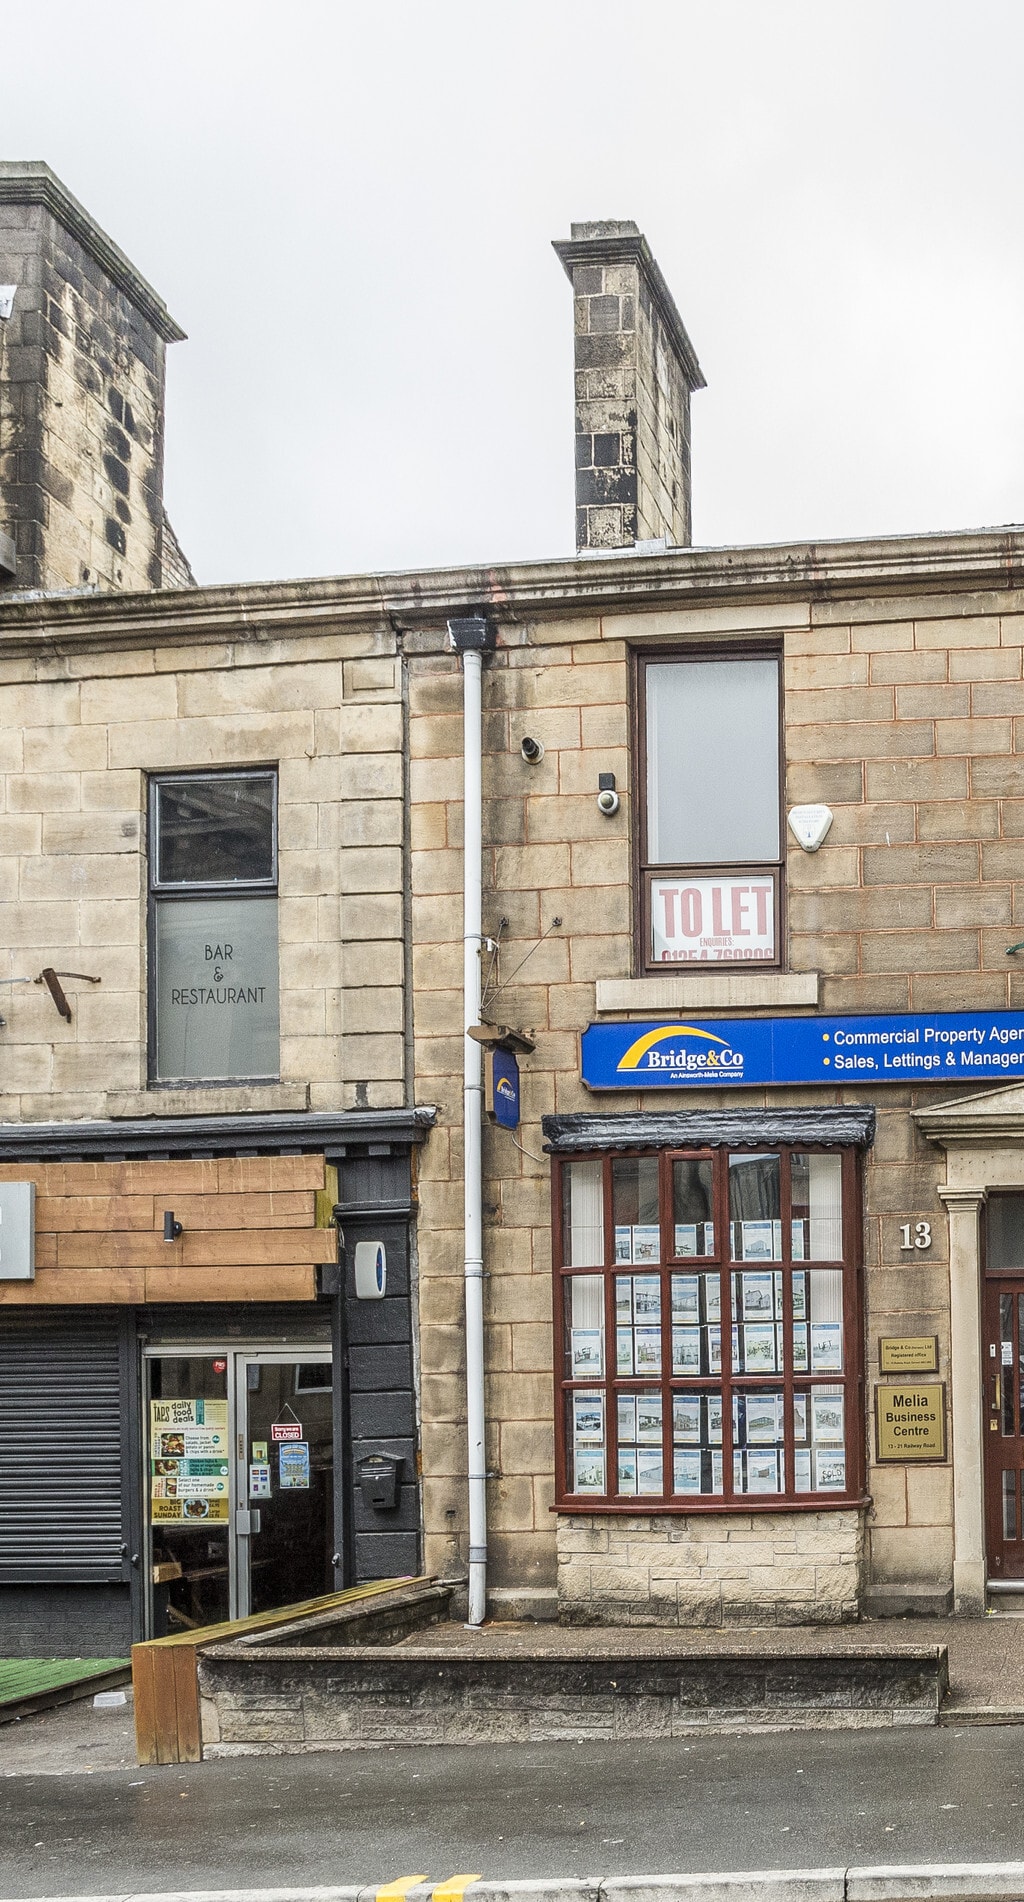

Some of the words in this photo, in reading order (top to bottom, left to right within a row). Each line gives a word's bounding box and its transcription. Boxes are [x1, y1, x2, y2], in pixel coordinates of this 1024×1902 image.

[658, 887, 703, 938] TO
[711, 886, 771, 937] LET
[699, 937, 735, 948] ENQUIRIES:
[204, 944, 234, 961] BAR
[213, 966, 224, 982] &
[171, 986, 266, 1005] RESTAURANT
[834, 1028, 919, 1045] Commercial
[924, 1027, 986, 1045] Property
[647, 1049, 744, 1070] Bridge&Co
[834, 1054, 879, 1070] Sales,
[884, 1052, 941, 1070] Lettings
[945, 1051, 956, 1066] &
[900, 1221, 932, 1249] 13
[171, 1400, 192, 1411] daily
[893, 1394, 928, 1407] Melia
[172, 1415, 195, 1424] deals
[173, 1408, 192, 1418] food
[886, 1411, 936, 1423] Business
[274, 1431, 300, 1439] CLOSED
[893, 1426, 930, 1436] Centre
